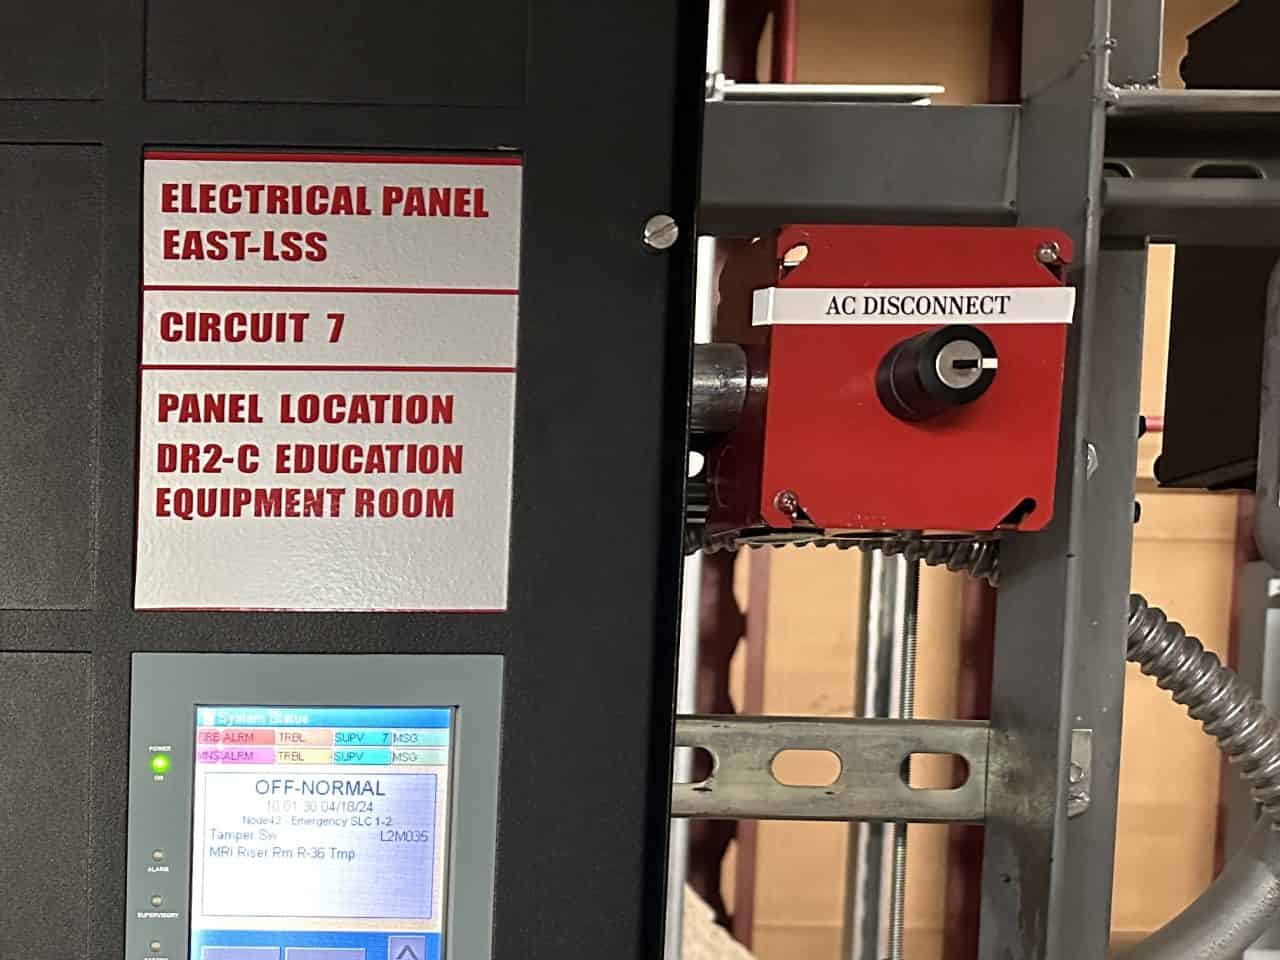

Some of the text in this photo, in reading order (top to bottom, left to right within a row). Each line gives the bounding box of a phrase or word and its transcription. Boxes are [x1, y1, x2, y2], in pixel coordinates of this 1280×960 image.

[161, 183, 489, 218] ELECTRICAL PANEL
[163, 230, 328, 262] EAST-LSS
[825, 295, 1011, 315] AC DISCONNECT
[160, 312, 346, 342] CIRCUIT 7
[157, 393, 454, 424] PANEL LOCATION
[156, 443, 464, 474] DR2-C EDUCATION
[155, 487, 454, 520] EQUIPMENT ROOM
[222, 732, 255, 743] ALRM
[279, 732, 306, 744] TRBL
[335, 732, 364, 744] SUPV
[392, 733, 418, 744] MSG
[221, 751, 254, 761] ALRM
[279, 751, 305, 762] TRBL
[334, 751, 363, 762] SUPV
[392, 751, 417, 762] MSG
[255, 779, 386, 796] OFF-NORMAL
[291, 816, 347, 827] Emergency
[351, 816, 372, 826] SLC
[375, 816, 393, 826] 1-2
[209, 828, 255, 843] Tamper
[209, 847, 233, 858] MRI
[237, 847, 268, 859] Riser
[272, 847, 293, 858] Rm
[329, 847, 356, 862] Tmp
